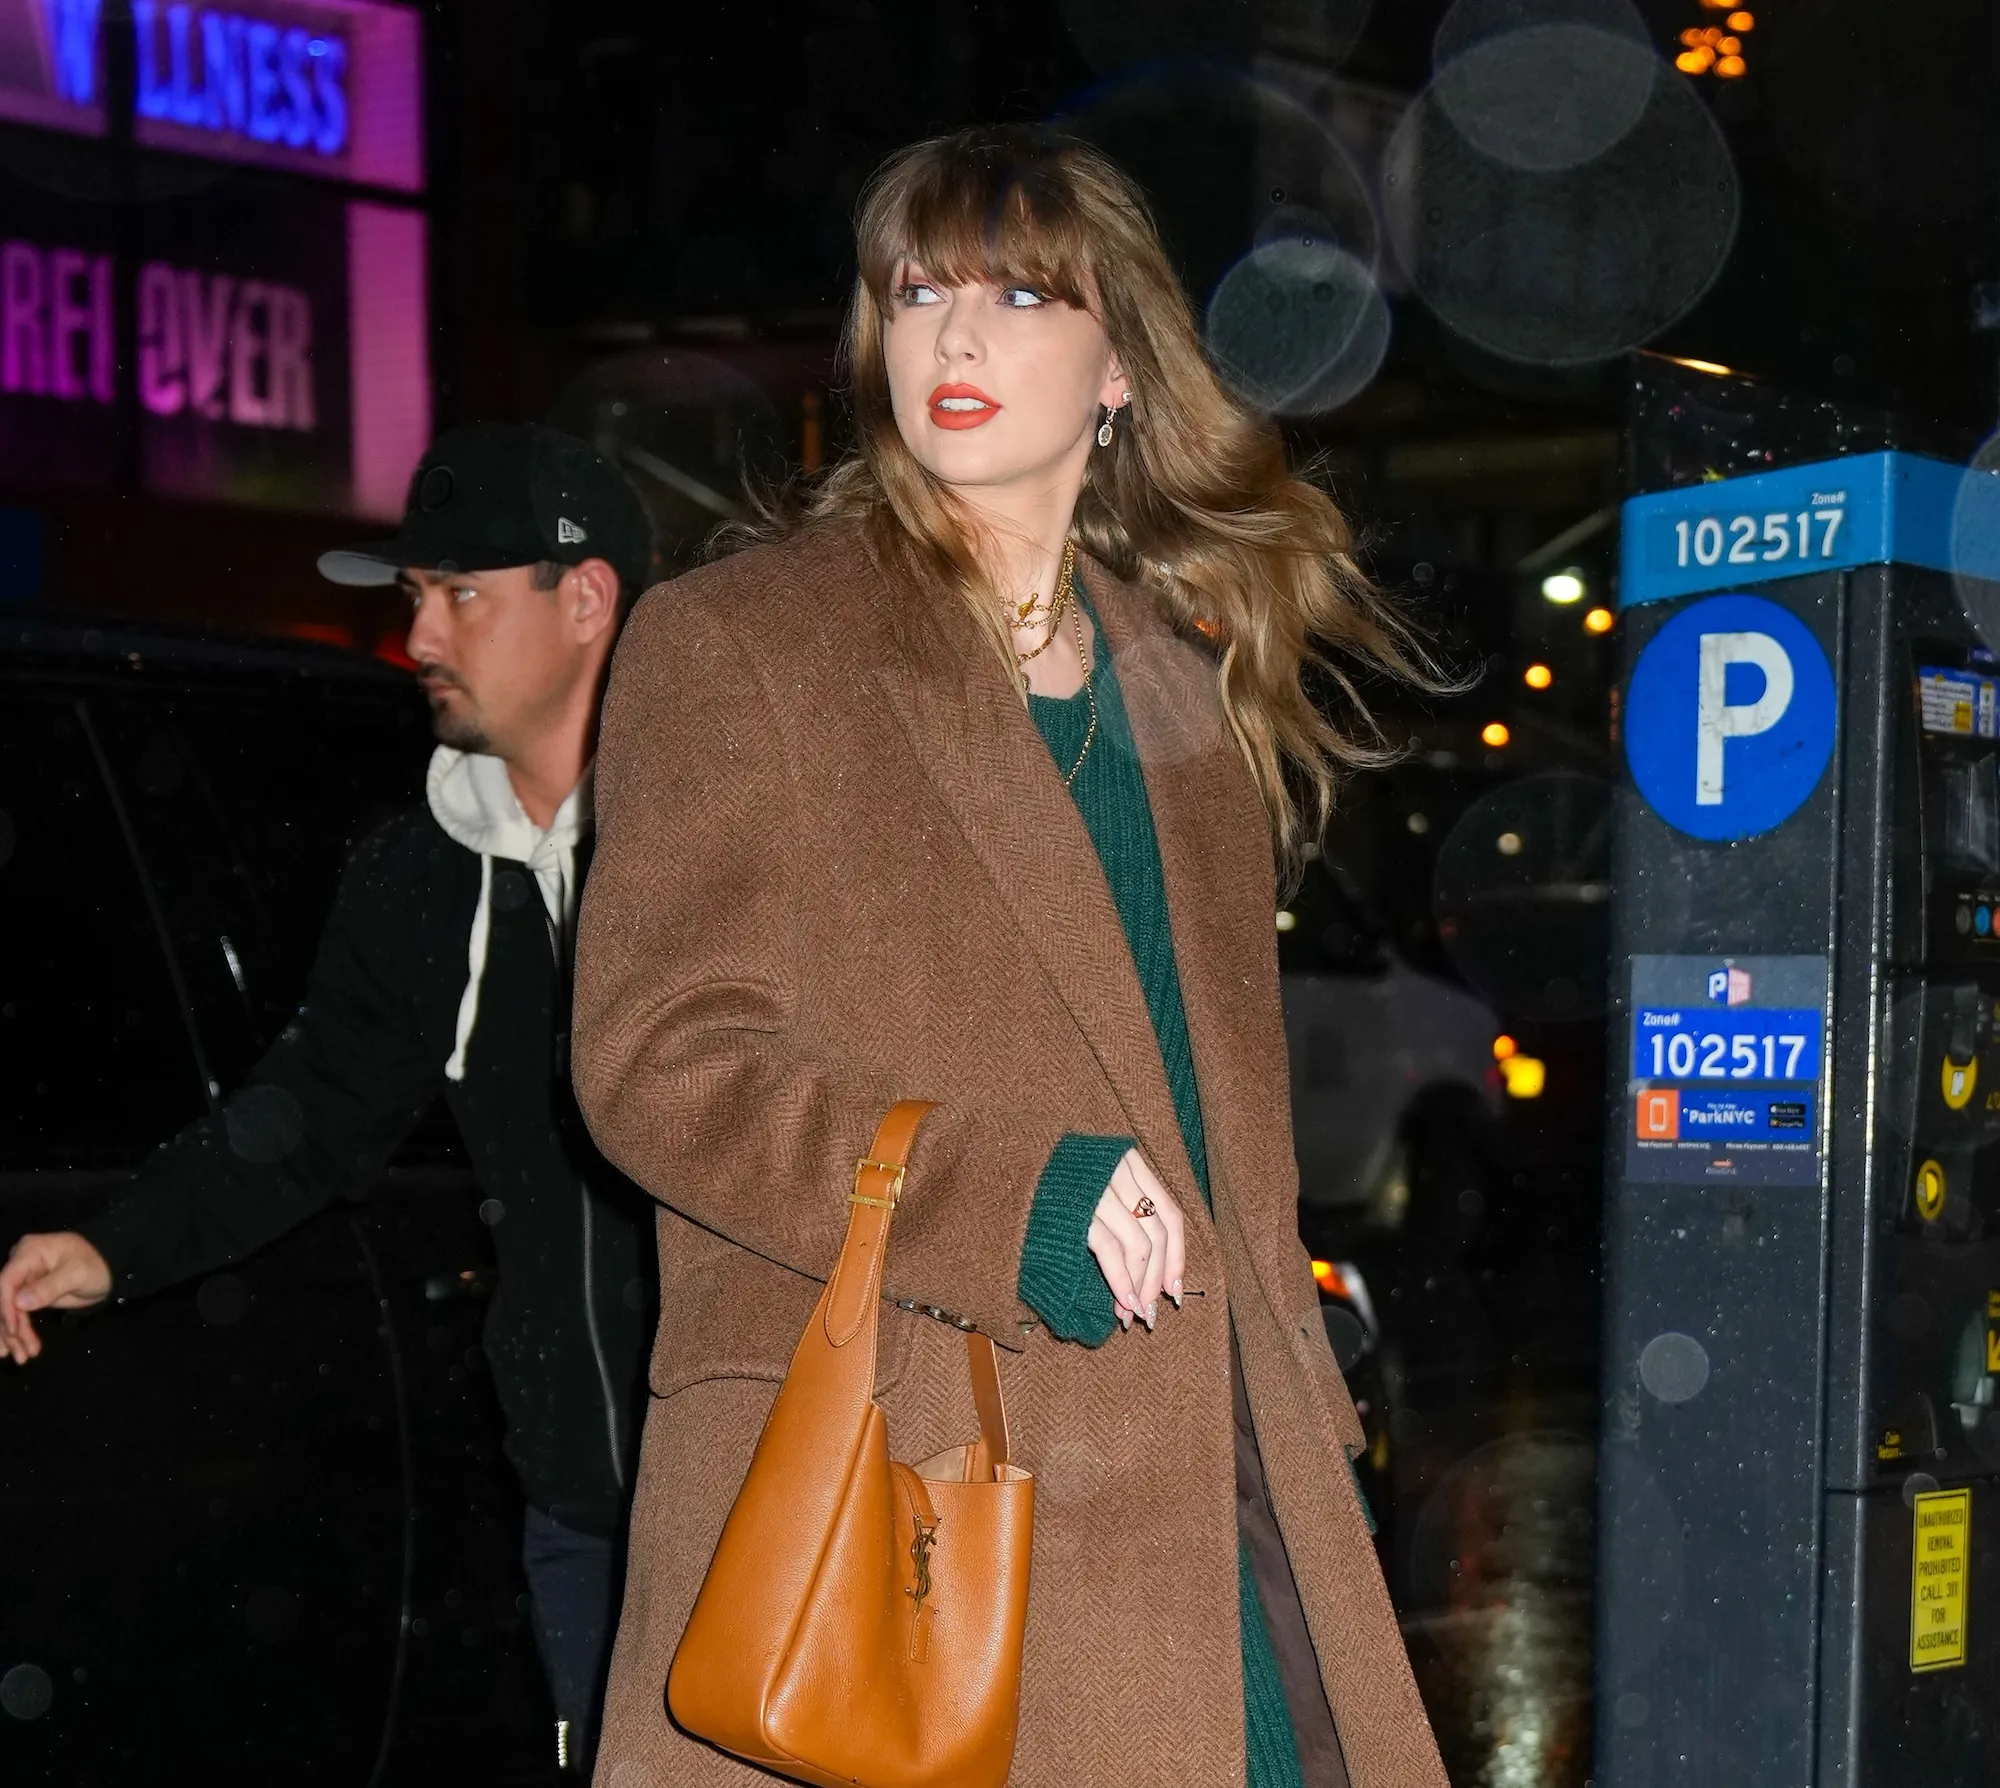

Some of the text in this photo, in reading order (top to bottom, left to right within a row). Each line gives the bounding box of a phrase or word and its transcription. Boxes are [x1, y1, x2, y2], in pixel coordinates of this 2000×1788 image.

[42, 0, 347, 155] WLLNESS
[1811, 490, 1846, 506] Zone#
[1675, 509, 1844, 567] 102517
[1696, 631, 1795, 806] P
[1643, 1012, 1680, 1026] Zone#
[1651, 1033, 1806, 1079] 102517
[1689, 1109, 1756, 1125] ParkNYC
[1919, 1508, 1963, 1528] UNAUTHORIZED
[1927, 1534, 1954, 1551] REMOVAL
[1918, 1557, 1961, 1577] PROHIBITED
[1920, 1582, 1958, 1601] CALL 311
[1931, 1607, 1946, 1624] FOR
[1916, 1628, 1960, 1651] ASSISTANCE
